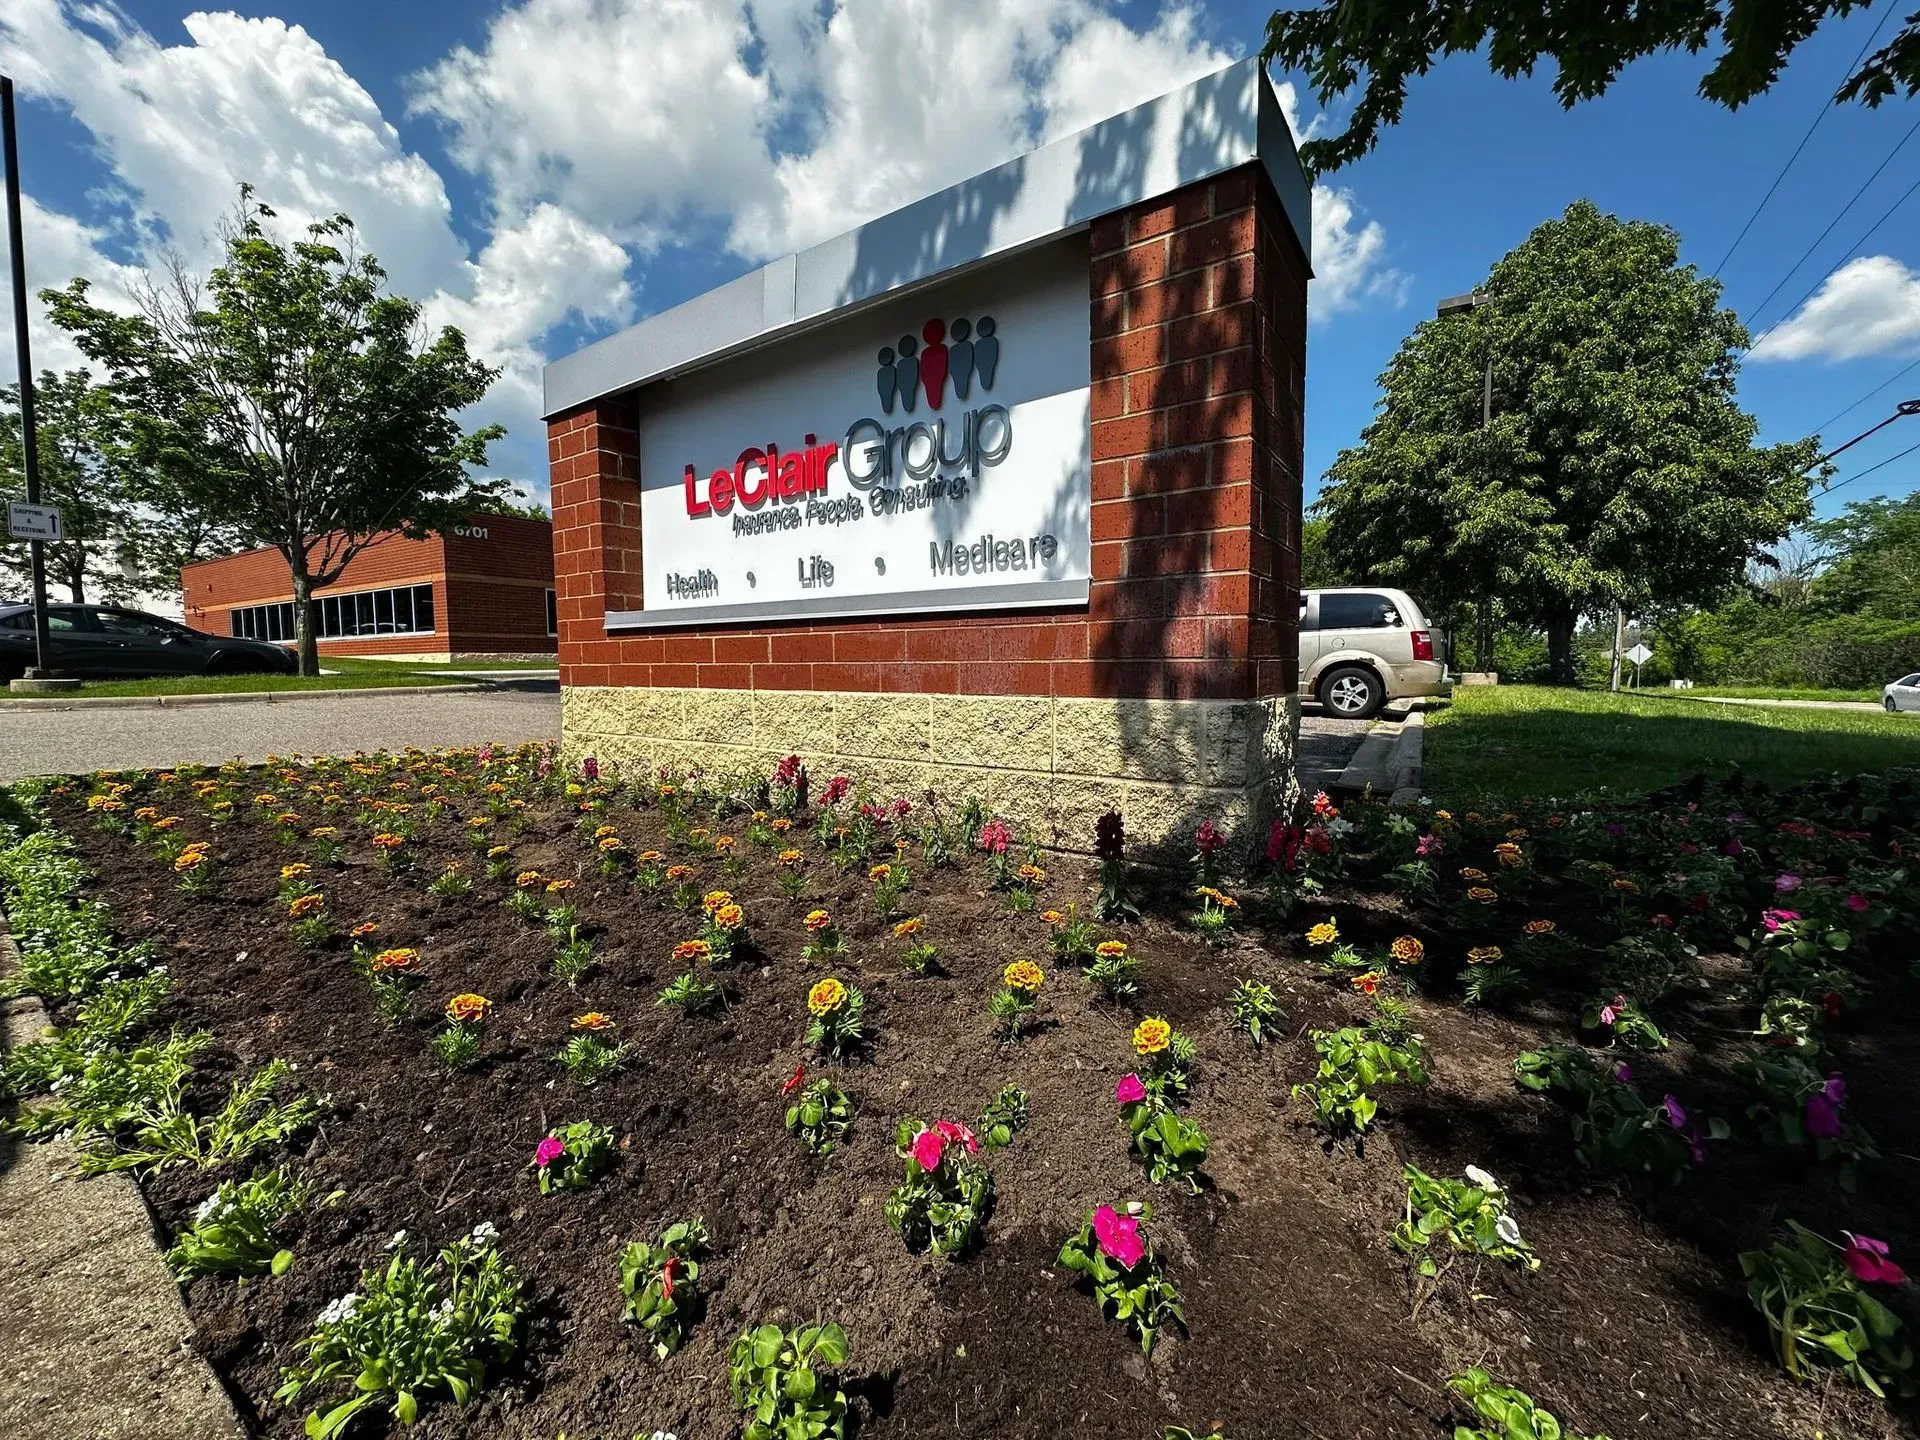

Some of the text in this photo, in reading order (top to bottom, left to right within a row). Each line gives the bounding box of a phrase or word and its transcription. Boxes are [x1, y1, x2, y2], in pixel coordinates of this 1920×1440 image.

[684, 403, 1014, 516] LeClair Group
[454, 524, 488, 539] 6701
[666, 533, 1058, 596] Health Life Medicare
